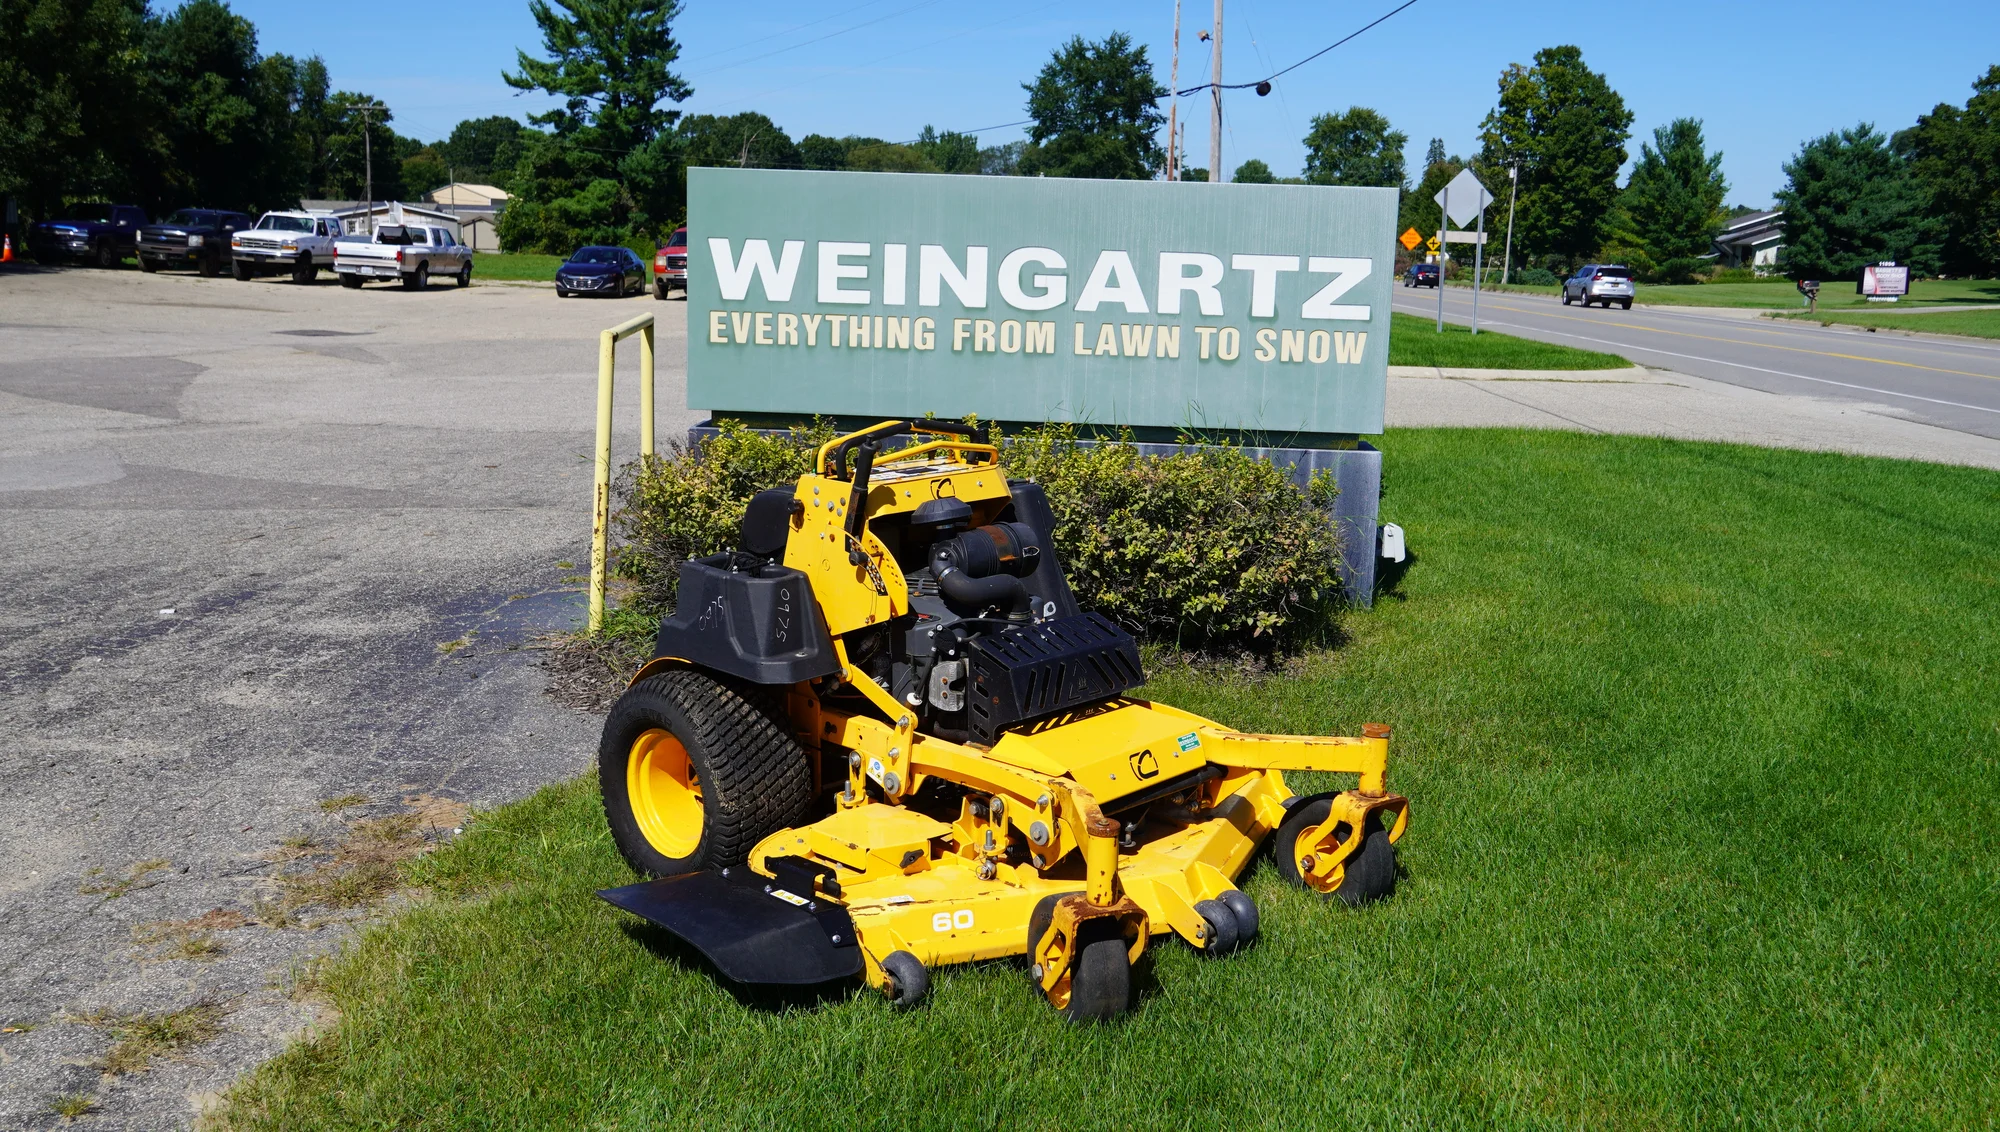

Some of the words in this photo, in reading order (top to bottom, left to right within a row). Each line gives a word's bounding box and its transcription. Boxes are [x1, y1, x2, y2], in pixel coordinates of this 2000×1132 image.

[707, 237, 1372, 321] WEINGARTZ
[709, 310, 936, 350] EVERYTHING
[953, 318, 1056, 354] FROM
[1074, 322, 1181, 358] LAWN
[1195, 326, 1240, 361] TO
[1254, 328, 1368, 364] SNOW
[776, 588, 790, 642] 0975
[932, 909, 974, 932] 60
